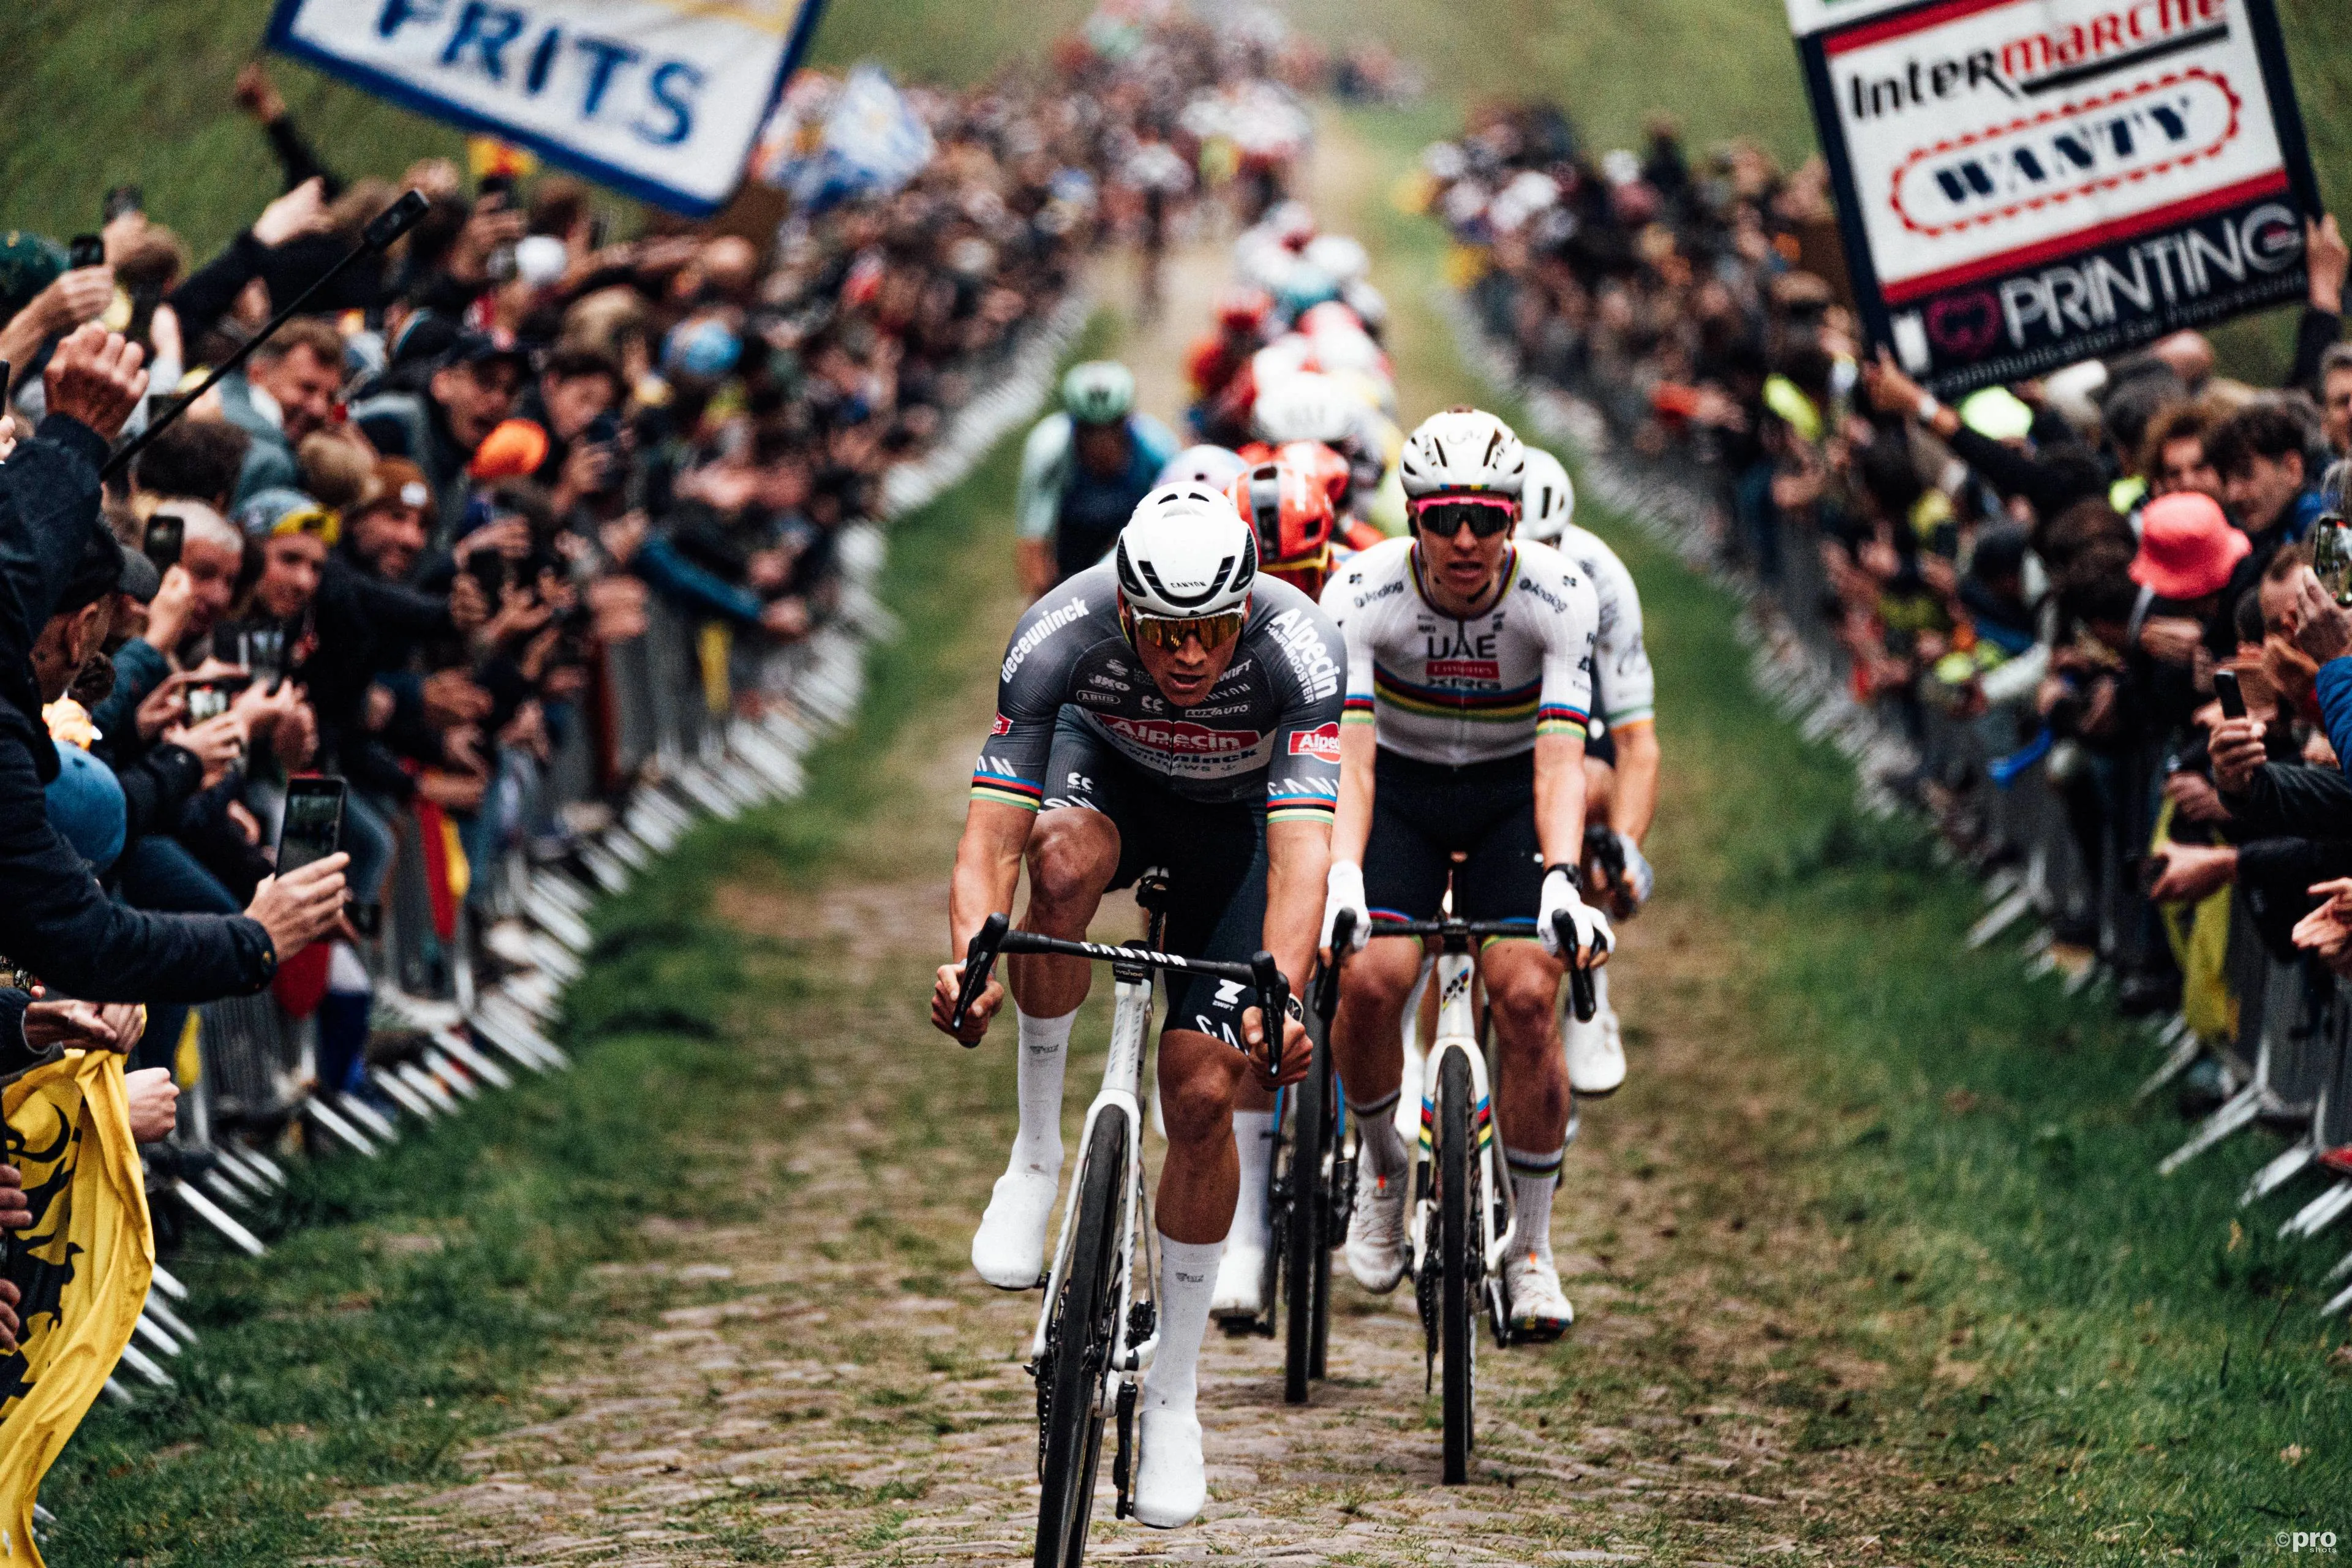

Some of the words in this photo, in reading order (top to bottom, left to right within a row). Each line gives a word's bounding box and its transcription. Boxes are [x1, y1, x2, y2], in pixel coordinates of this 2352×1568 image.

[377, 0, 706, 147] FRITS
[1934, 95, 2193, 204] WANTY
[1999, 203, 2305, 349] PRINTING
[1001, 597, 1090, 684] deceuninck
[1269, 608, 1338, 701] Alpecin
[1428, 634, 1498, 658] UAE
[1218, 658, 1252, 682] WIFT
[1264, 624, 1289, 648] HAIR
[1286, 647, 1315, 704] BOOSTER
[1081, 693, 1114, 703] ABUS
[1204, 683, 1251, 702] NYON
[1112, 720, 1242, 750] Alpecin
[1080, 941, 1188, 967] CANYON
[1115, 968, 1144, 978] wahoo
